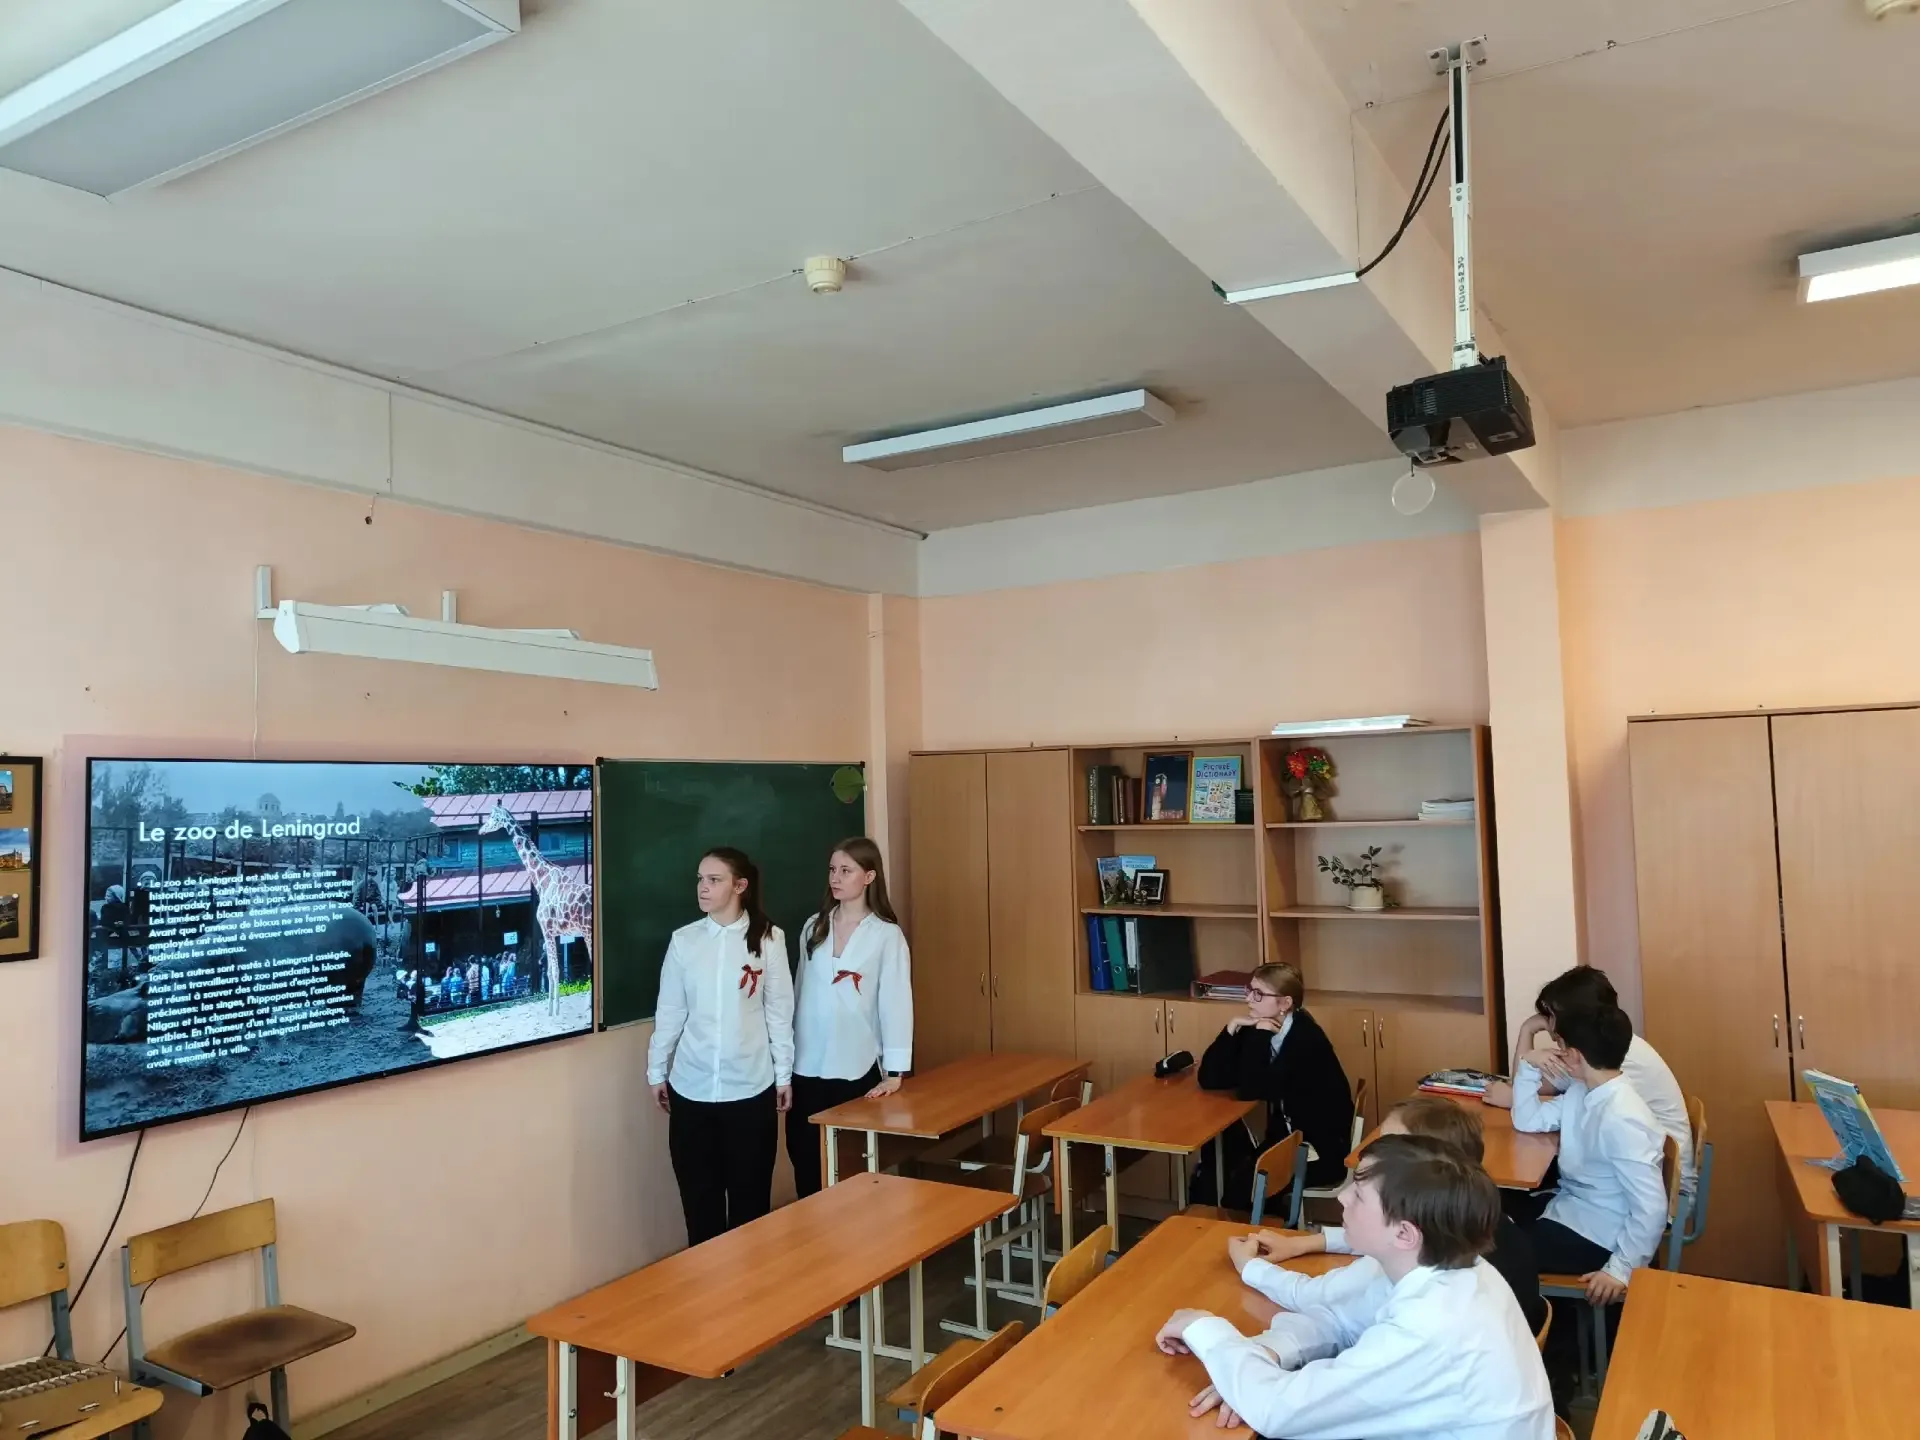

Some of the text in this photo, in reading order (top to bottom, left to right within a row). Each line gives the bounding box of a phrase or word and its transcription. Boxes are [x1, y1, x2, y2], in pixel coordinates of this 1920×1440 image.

[139, 816, 361, 842] Le zoo de Leningrad
[149, 879, 161, 888] Le
[184, 877, 196, 885] de
[199, 874, 244, 885] Leningrad
[260, 872, 279, 881] situé
[281, 871, 301, 879] dans
[312, 869, 337, 877] centre
[149, 890, 195, 900] historique
[197, 888, 210, 897] de
[293, 882, 313, 890] dans
[314, 881, 322, 889] le
[323, 879, 355, 889] quartier
[149, 900, 211, 913] Petrogradsky
[235, 897, 251, 905] loin
[253, 895, 264, 904] du
[266, 896, 286, 905] parc
[149, 916, 165, 926] Les
[167, 914, 201, 924] années
[202, 911, 214, 920] du
[216, 910, 244, 919] blocus
[328, 901, 337, 909] le
[148, 928, 177, 938] Avant
[179, 927, 197, 936] que
[239, 920, 251, 929] de
[253, 918, 280, 928] blocus
[281, 918, 292, 926] ne
[332, 912, 344, 920] les
[148, 938, 194, 951] employés
[212, 933, 238, 944] réussi
[240, 932, 247, 940] à
[248, 931, 282, 940] évacuer
[283, 928, 314, 937] environ
[315, 924, 327, 933] 80
[148, 946, 247, 963] individus les animaux.
[148, 973, 169, 981] Tous
[170, 970, 184, 979] les
[186, 967, 216, 976] autres
[217, 964, 235, 973] sont
[236, 961, 263, 971] restés
[264, 959, 271, 968] à
[272, 954, 314, 967] Leningrad
[148, 985, 172, 994] Mais
[173, 982, 187, 991] les
[188, 976, 239, 989] travailleurs
[240, 973, 253, 982] du
[254, 973, 271, 981] zoo
[311, 964, 320, 973] le
[321, 962, 346, 972] blocus
[147, 997, 163, 1007] ont
[165, 993, 192, 1004] réussi
[193, 991, 201, 1000] à
[202, 988, 233, 999] sauver
[234, 985, 251, 994] des
[252, 981, 288, 992] dizaines
[200, 1002, 214, 1011] les
[215, 1000, 245, 1010] singes,
[147, 994, 354, 1032] Nilgau et les chameaux ont survécu à ces années
[146, 1048, 160, 1057] on
[161, 1045, 173, 1054] lui
[185, 1038, 211, 1050] laissé
[212, 1037, 222, 1046] le
[223, 1034, 243, 1044] nom
[243, 1031, 257, 1041] de
[258, 1023, 301, 1038] Leningrad
[301, 1020, 326, 1031] même
[327, 1015, 350, 1027] après
[147, 1031, 189, 1045] terribles.
[191, 1028, 203, 1037] En
[265, 1015, 278, 1025] tel
[279, 1011, 308, 1024] exploit
[146, 1044, 251, 1069] avoir renommé la ville.
